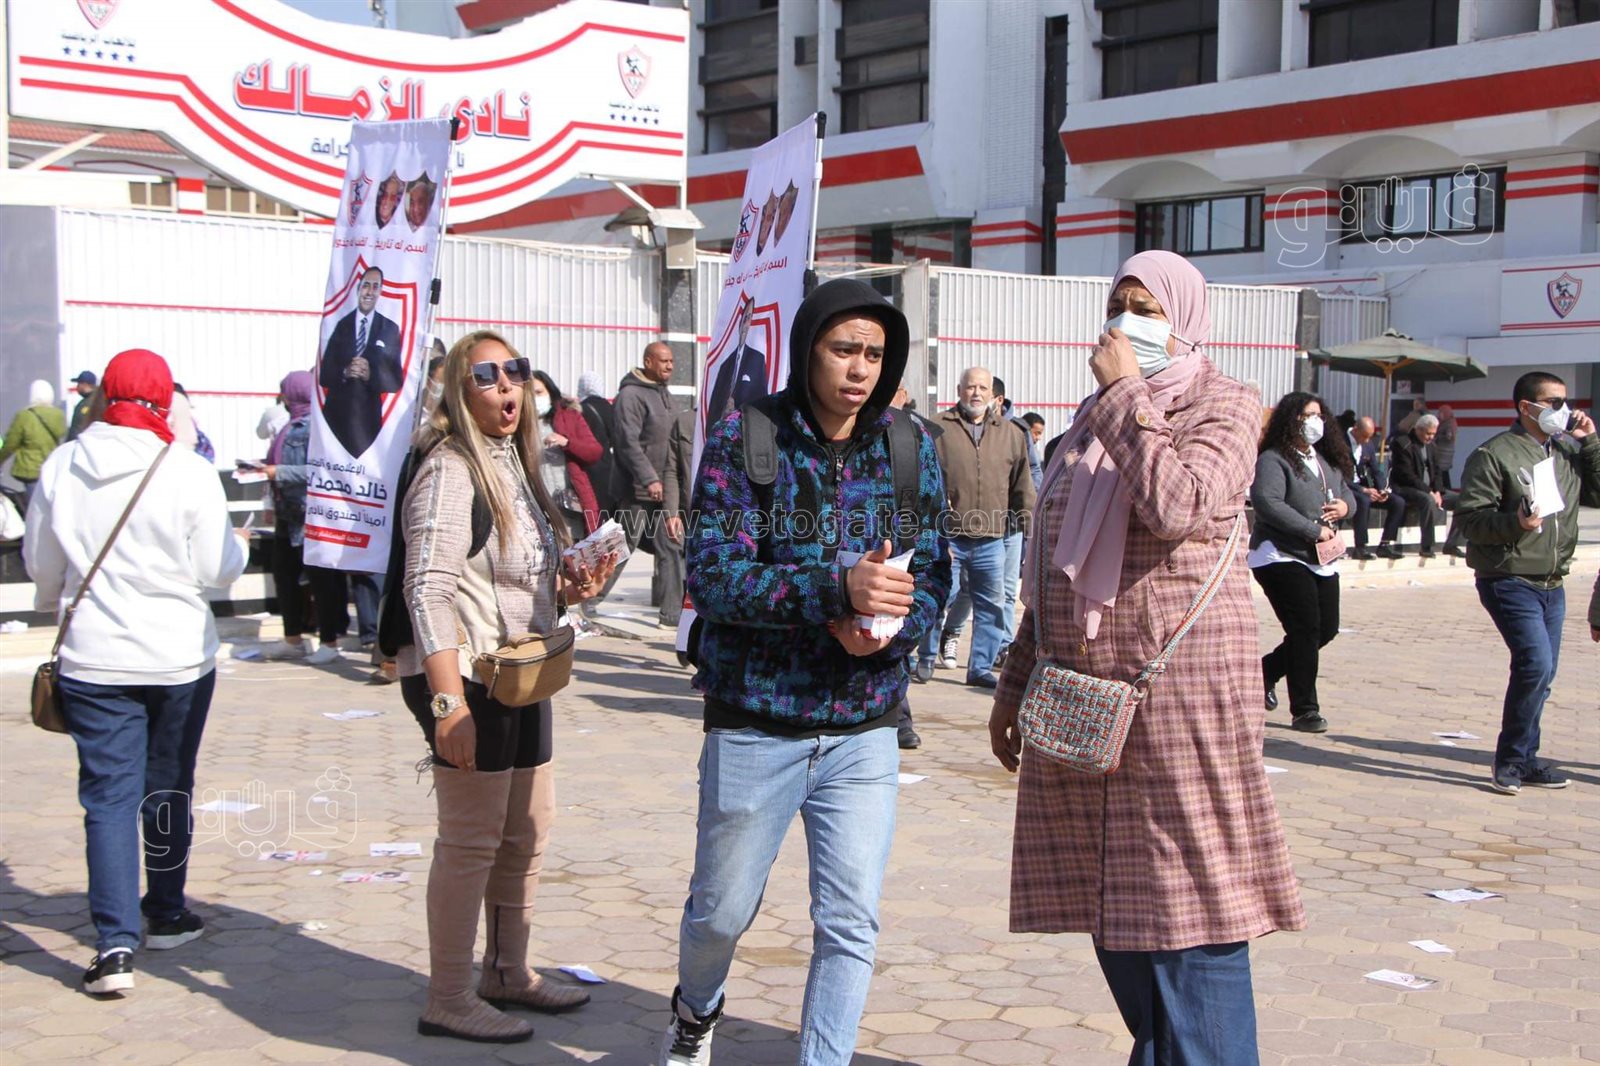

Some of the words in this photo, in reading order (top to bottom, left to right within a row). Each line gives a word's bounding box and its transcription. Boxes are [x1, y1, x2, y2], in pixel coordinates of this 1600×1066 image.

[232, 58, 426, 123] الزمالك
[315, 478, 353, 495] محمد
[355, 481, 388, 500] خالد
